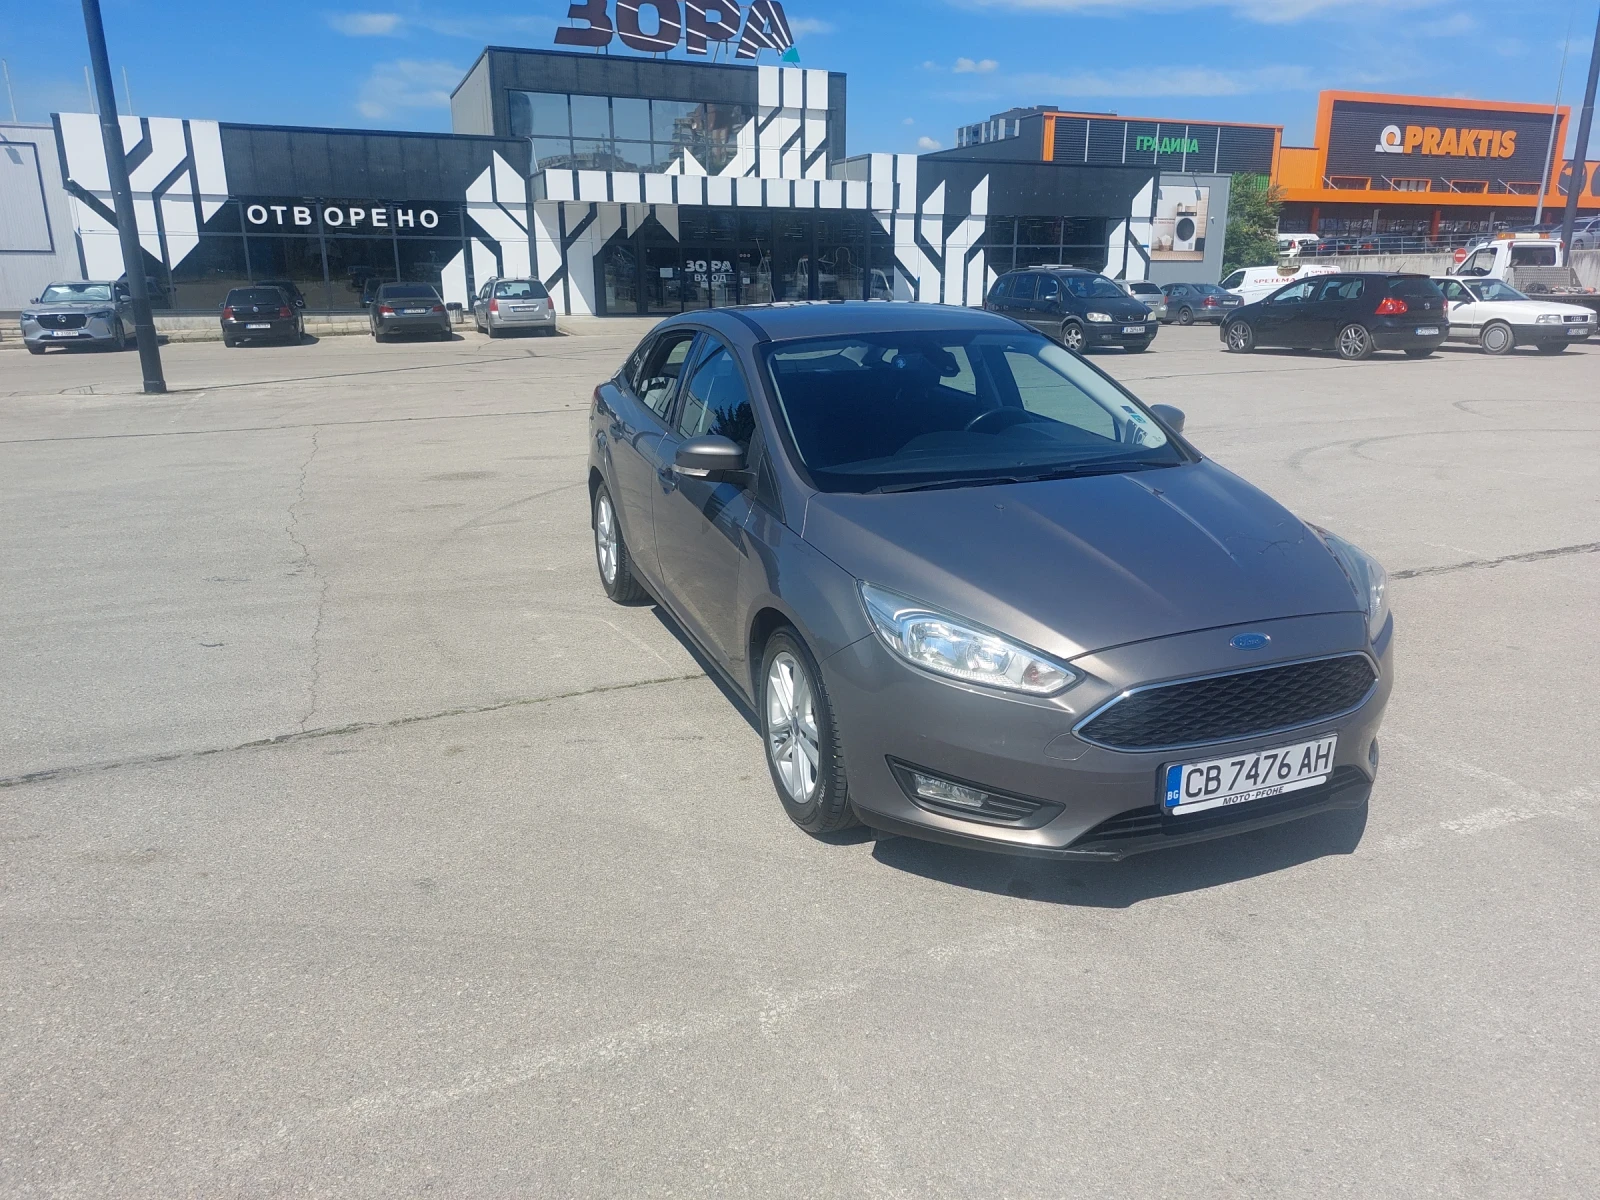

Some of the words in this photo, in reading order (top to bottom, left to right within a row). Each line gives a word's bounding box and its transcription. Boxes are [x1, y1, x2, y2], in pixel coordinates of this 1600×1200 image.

[554, 0, 795, 59] ЗОРА
[1135, 135, 1199, 155] ГРАДИНА
[1403, 125, 1518, 158] PRAKTIS
[1185, 765, 1221, 798] CB
[1228, 751, 1292, 791] 7476
[1297, 741, 1333, 776] AH
[1166, 789, 1179, 801] BG
